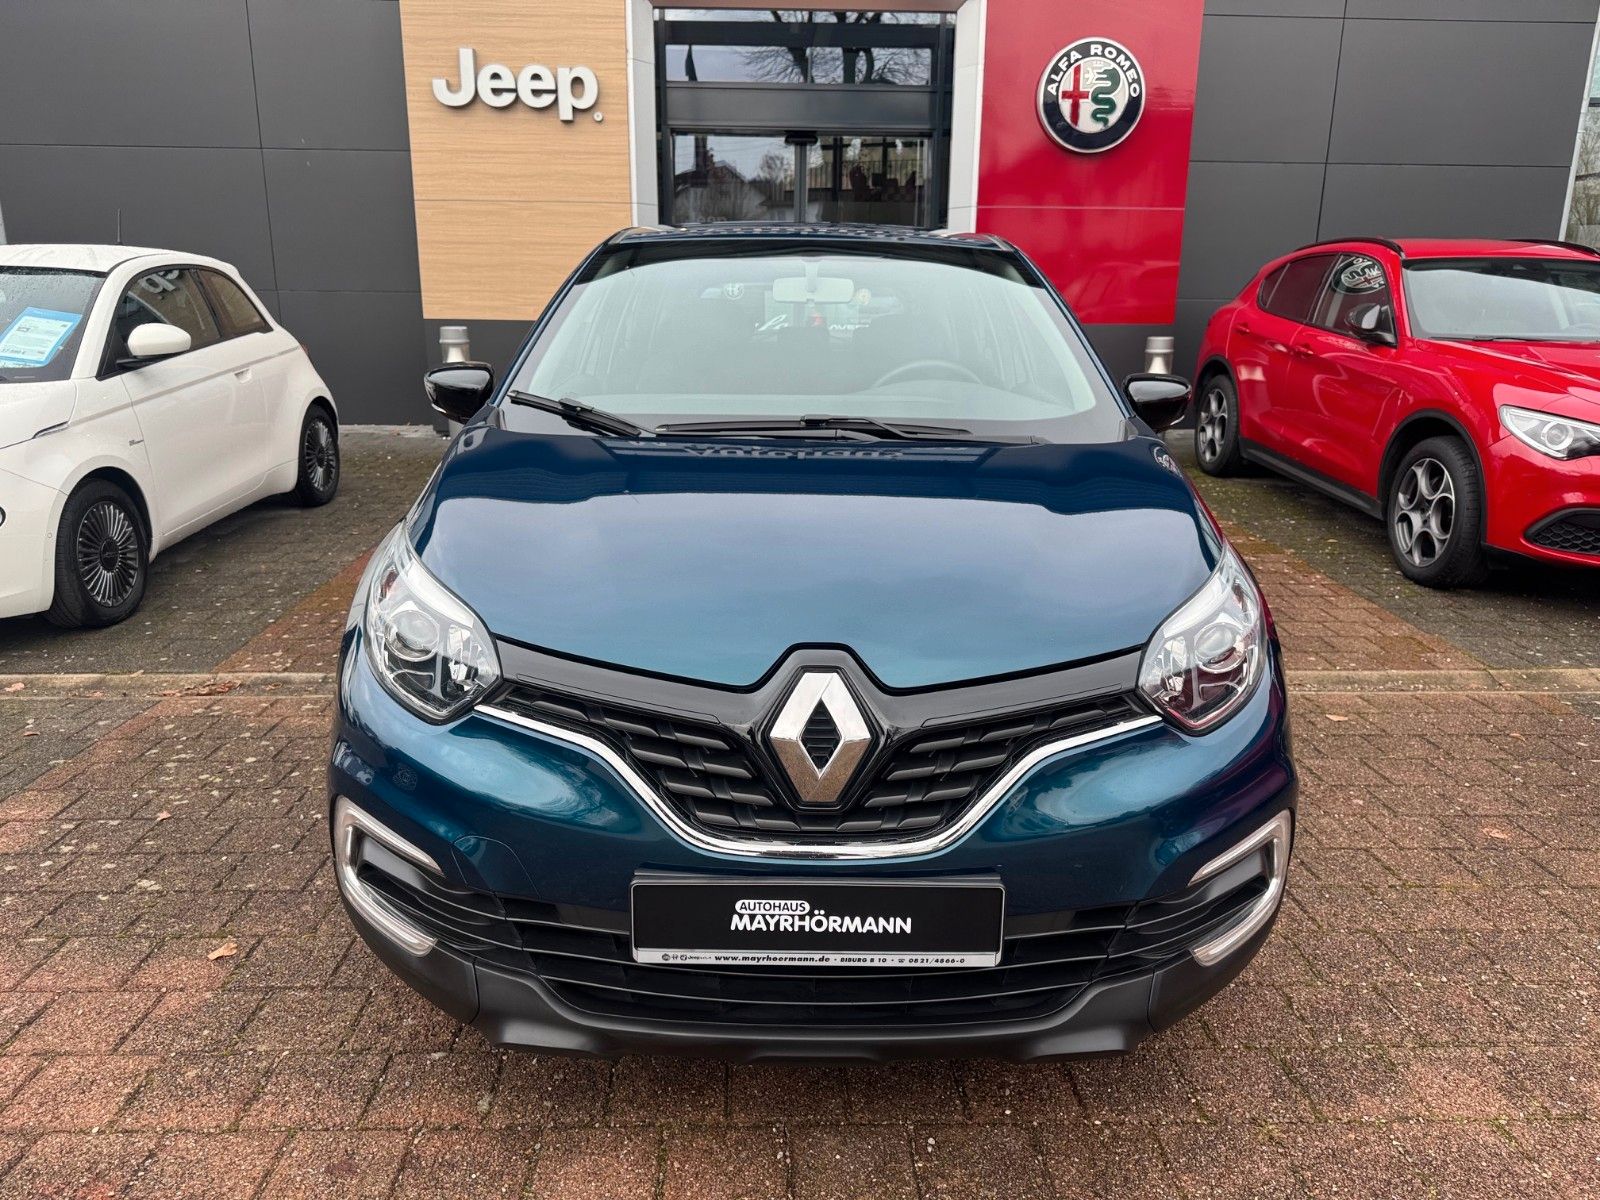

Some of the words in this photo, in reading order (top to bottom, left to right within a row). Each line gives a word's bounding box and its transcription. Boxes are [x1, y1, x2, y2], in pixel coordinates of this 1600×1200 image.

[1046, 49, 1083, 96] ALFA
[1089, 43, 1141, 98] ROMEO
[432, 47, 599, 122] Jeep
[739, 901, 806, 912] AUTOHAUS
[730, 909, 912, 934] MAYRHÖRMANN
[714, 954, 831, 963] www.mayrhoermann.de
